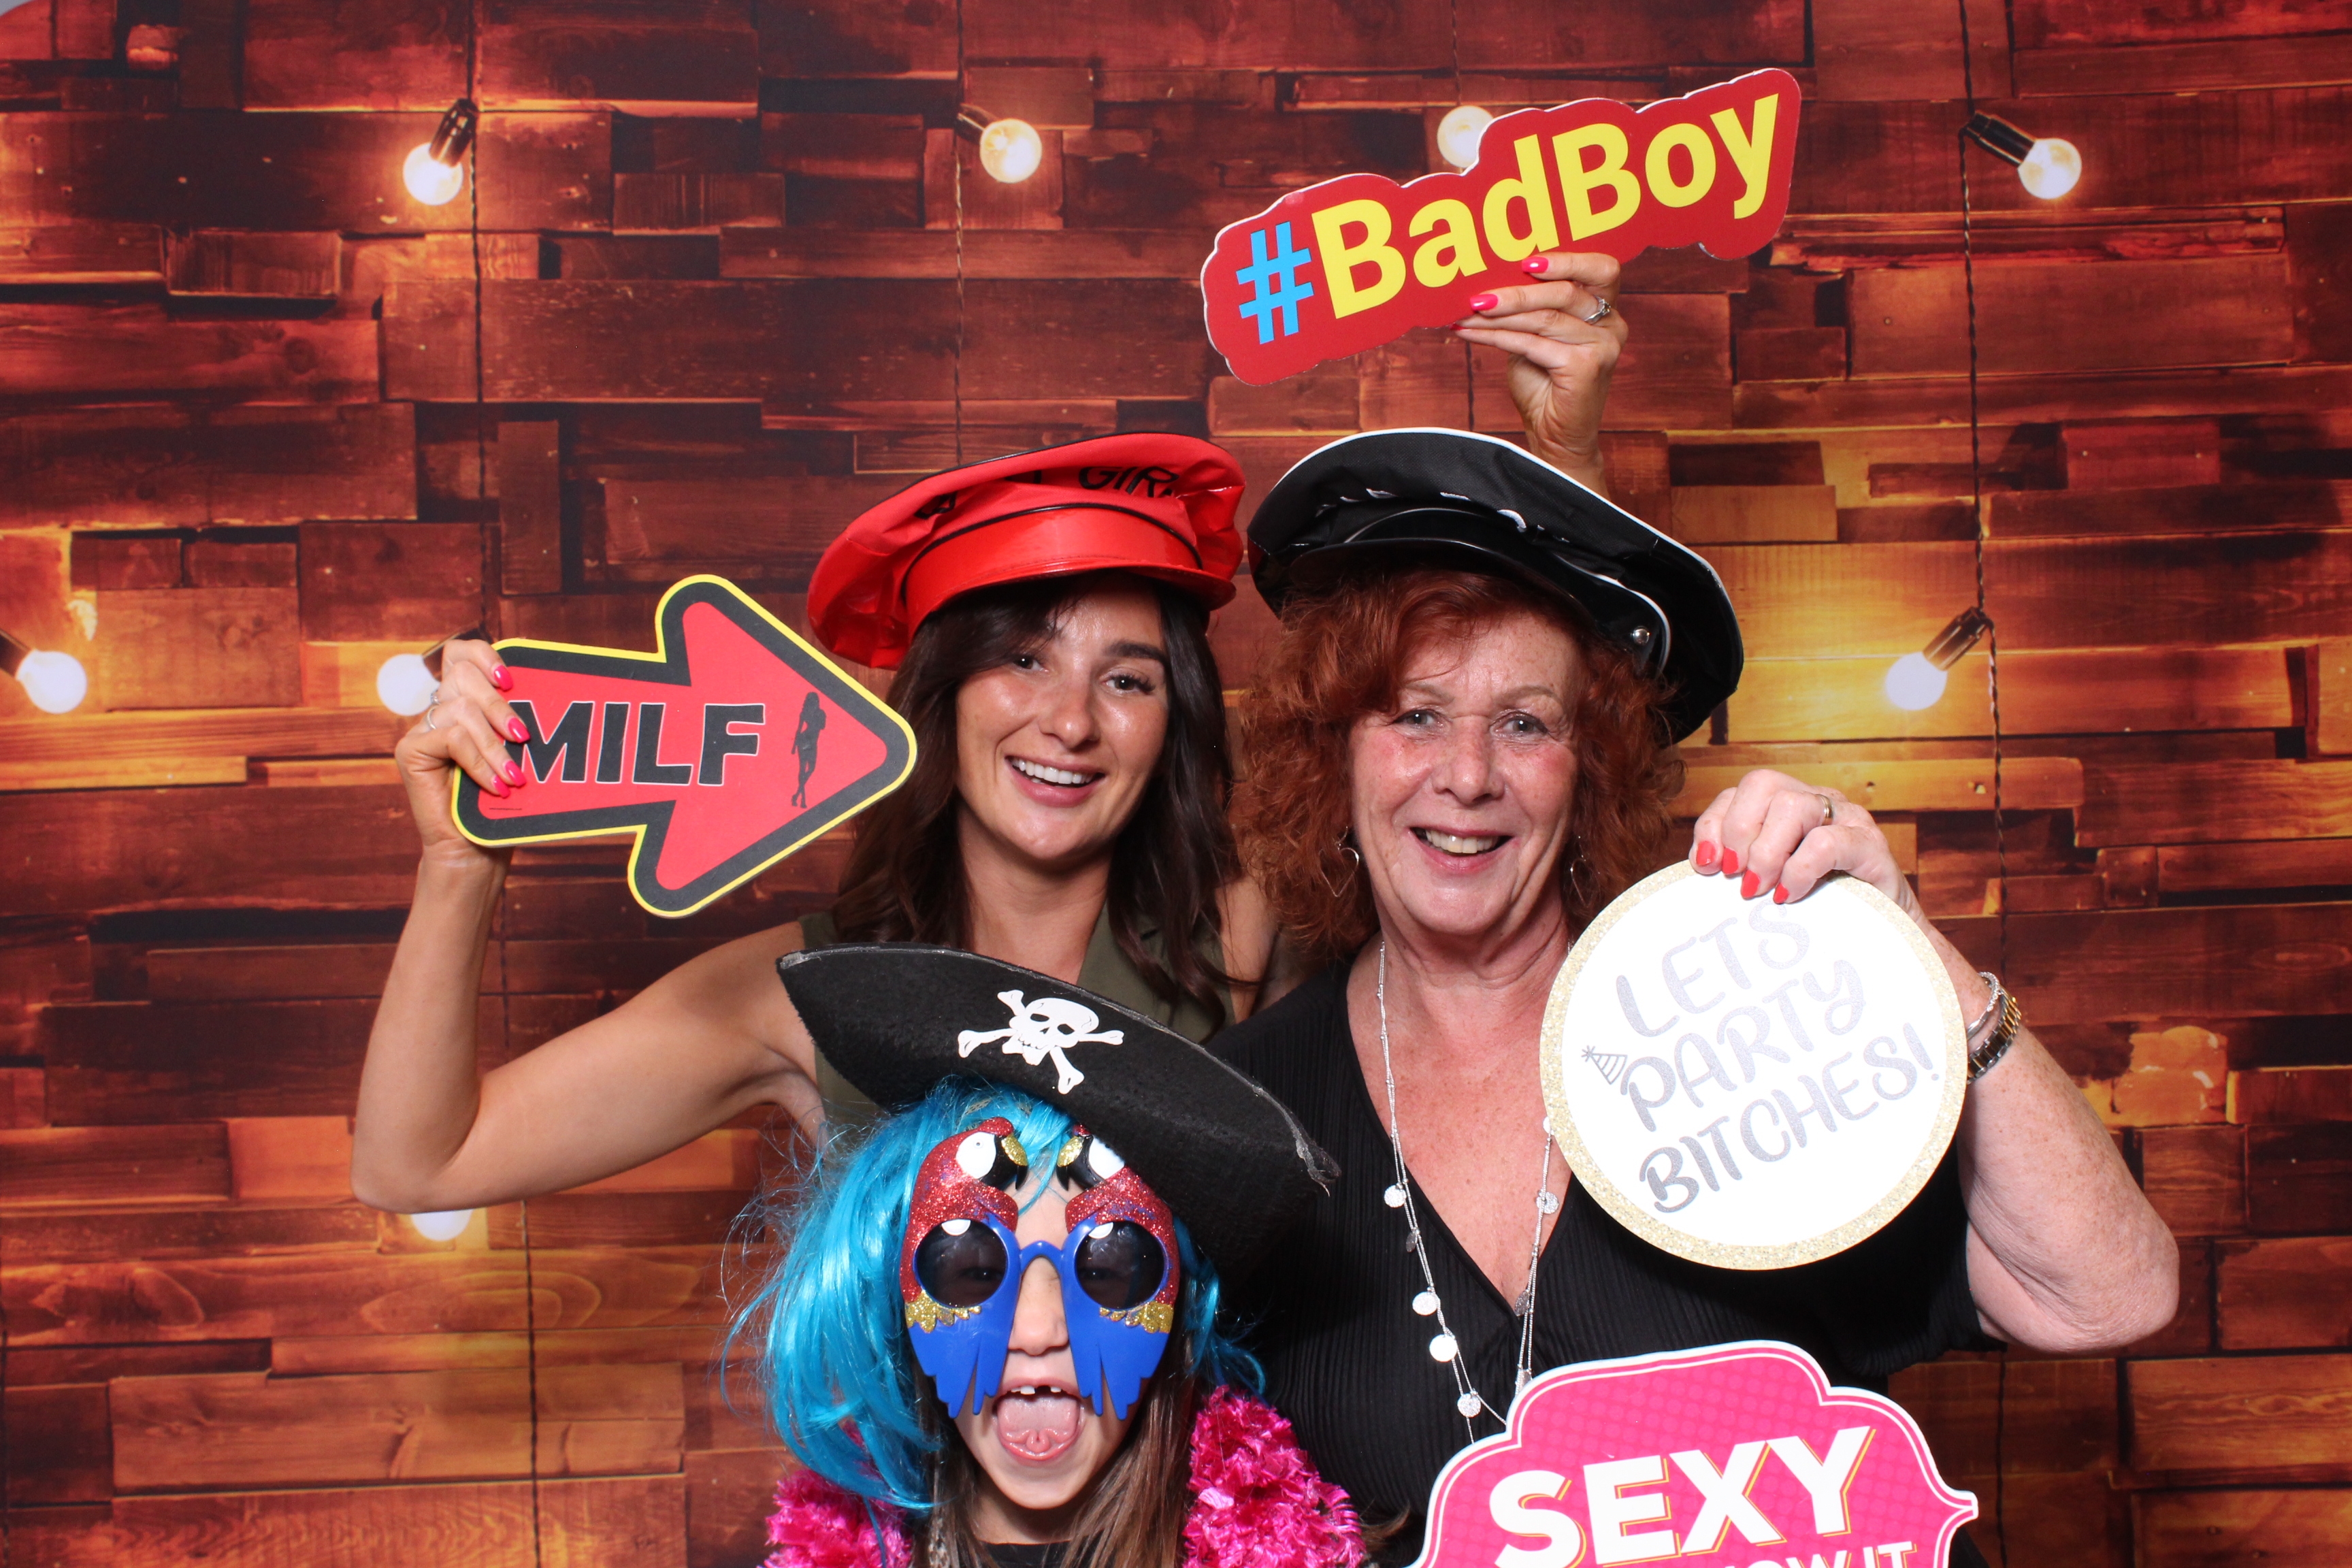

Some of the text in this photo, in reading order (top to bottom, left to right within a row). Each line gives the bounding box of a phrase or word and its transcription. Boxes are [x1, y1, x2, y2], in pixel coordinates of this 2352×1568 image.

[1236, 93, 1778, 344] #BadBoy
[504, 700, 765, 787] MILF
[1616, 898, 1810, 1037] LETS
[1620, 960, 1867, 1132] PARTY
[1639, 1023, 1940, 1213] BITCHES!
[1489, 1425, 1876, 1568] SEXY
